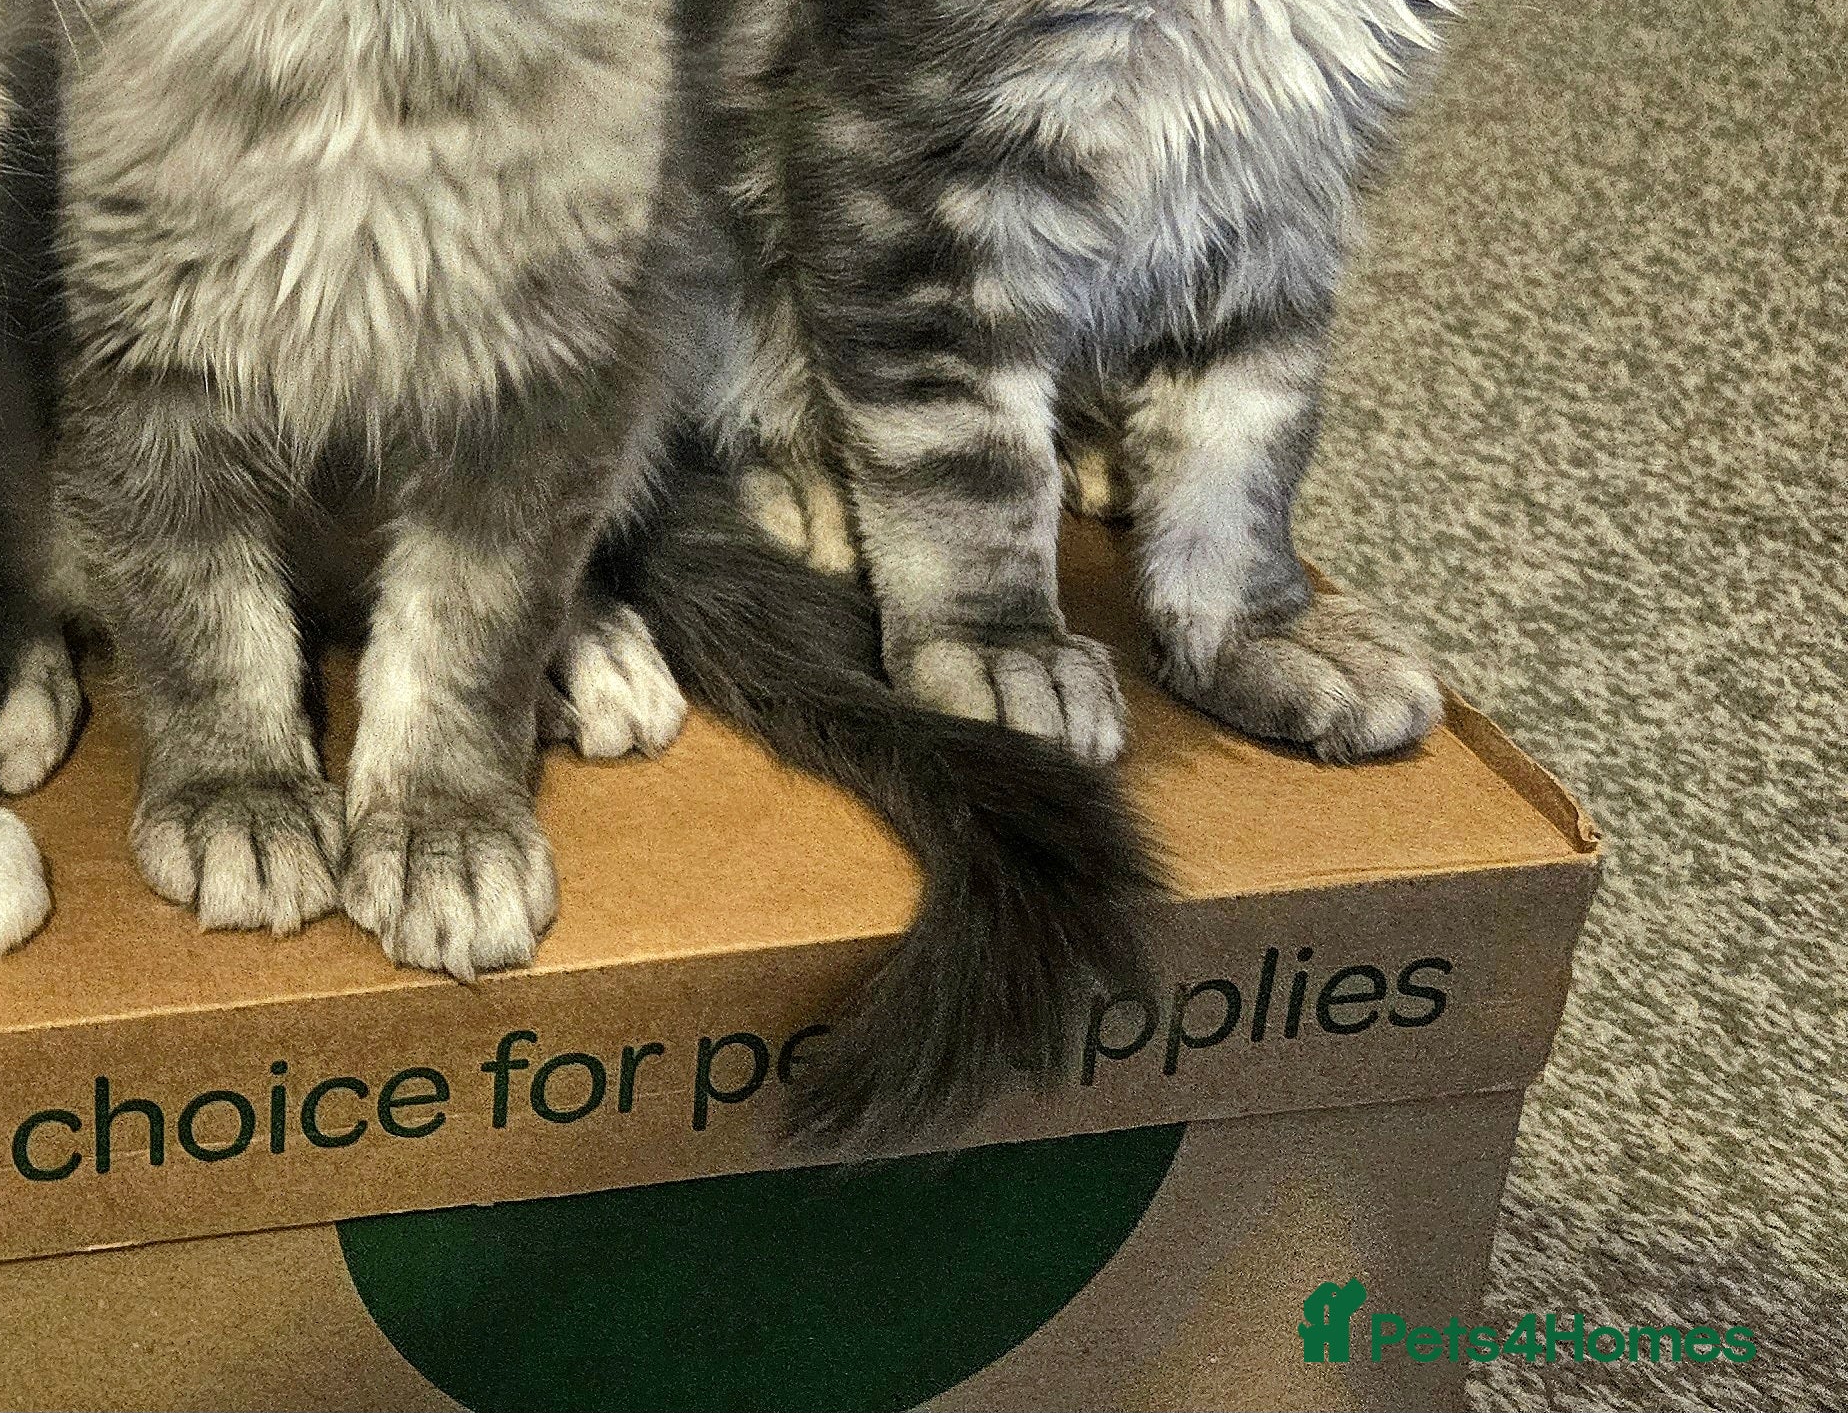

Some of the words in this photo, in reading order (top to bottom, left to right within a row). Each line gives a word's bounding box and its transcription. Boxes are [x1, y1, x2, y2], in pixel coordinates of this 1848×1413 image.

[11, 1060, 450, 1182] choice
[481, 1030, 665, 1129] for
[1080, 945, 1453, 1087] pplies
